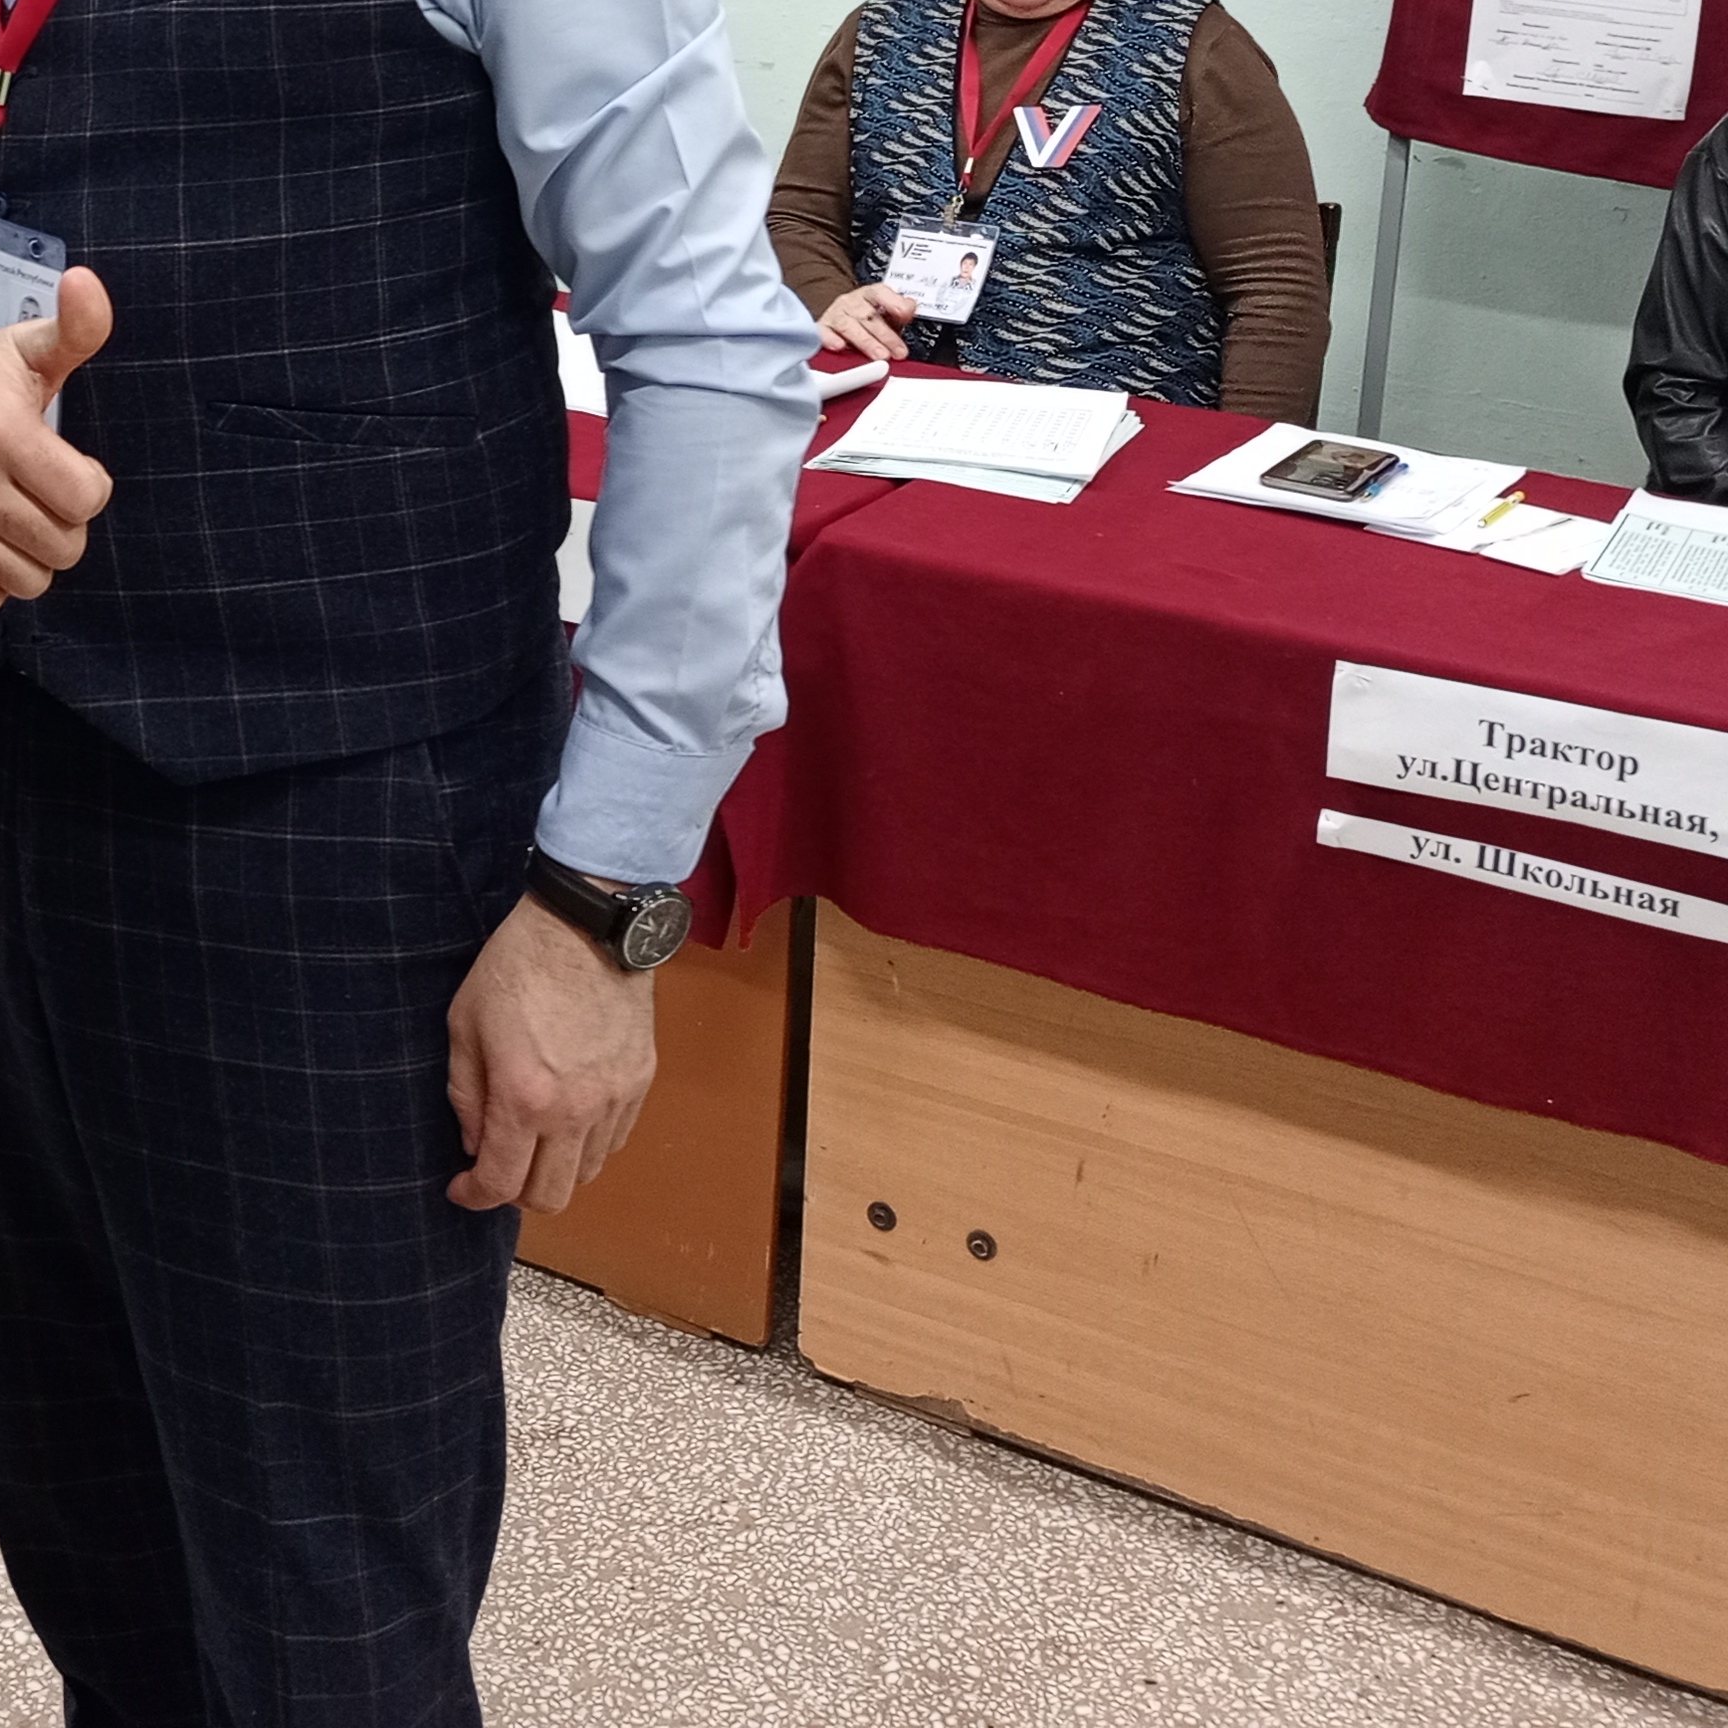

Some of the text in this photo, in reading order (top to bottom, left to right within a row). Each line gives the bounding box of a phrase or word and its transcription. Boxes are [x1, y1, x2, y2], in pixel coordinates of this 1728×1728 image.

[1478, 719, 1640, 782] Трактор
[1396, 754, 1719, 843] ул.Центральная,
[1409, 834, 1680, 918] ул. Школьная
